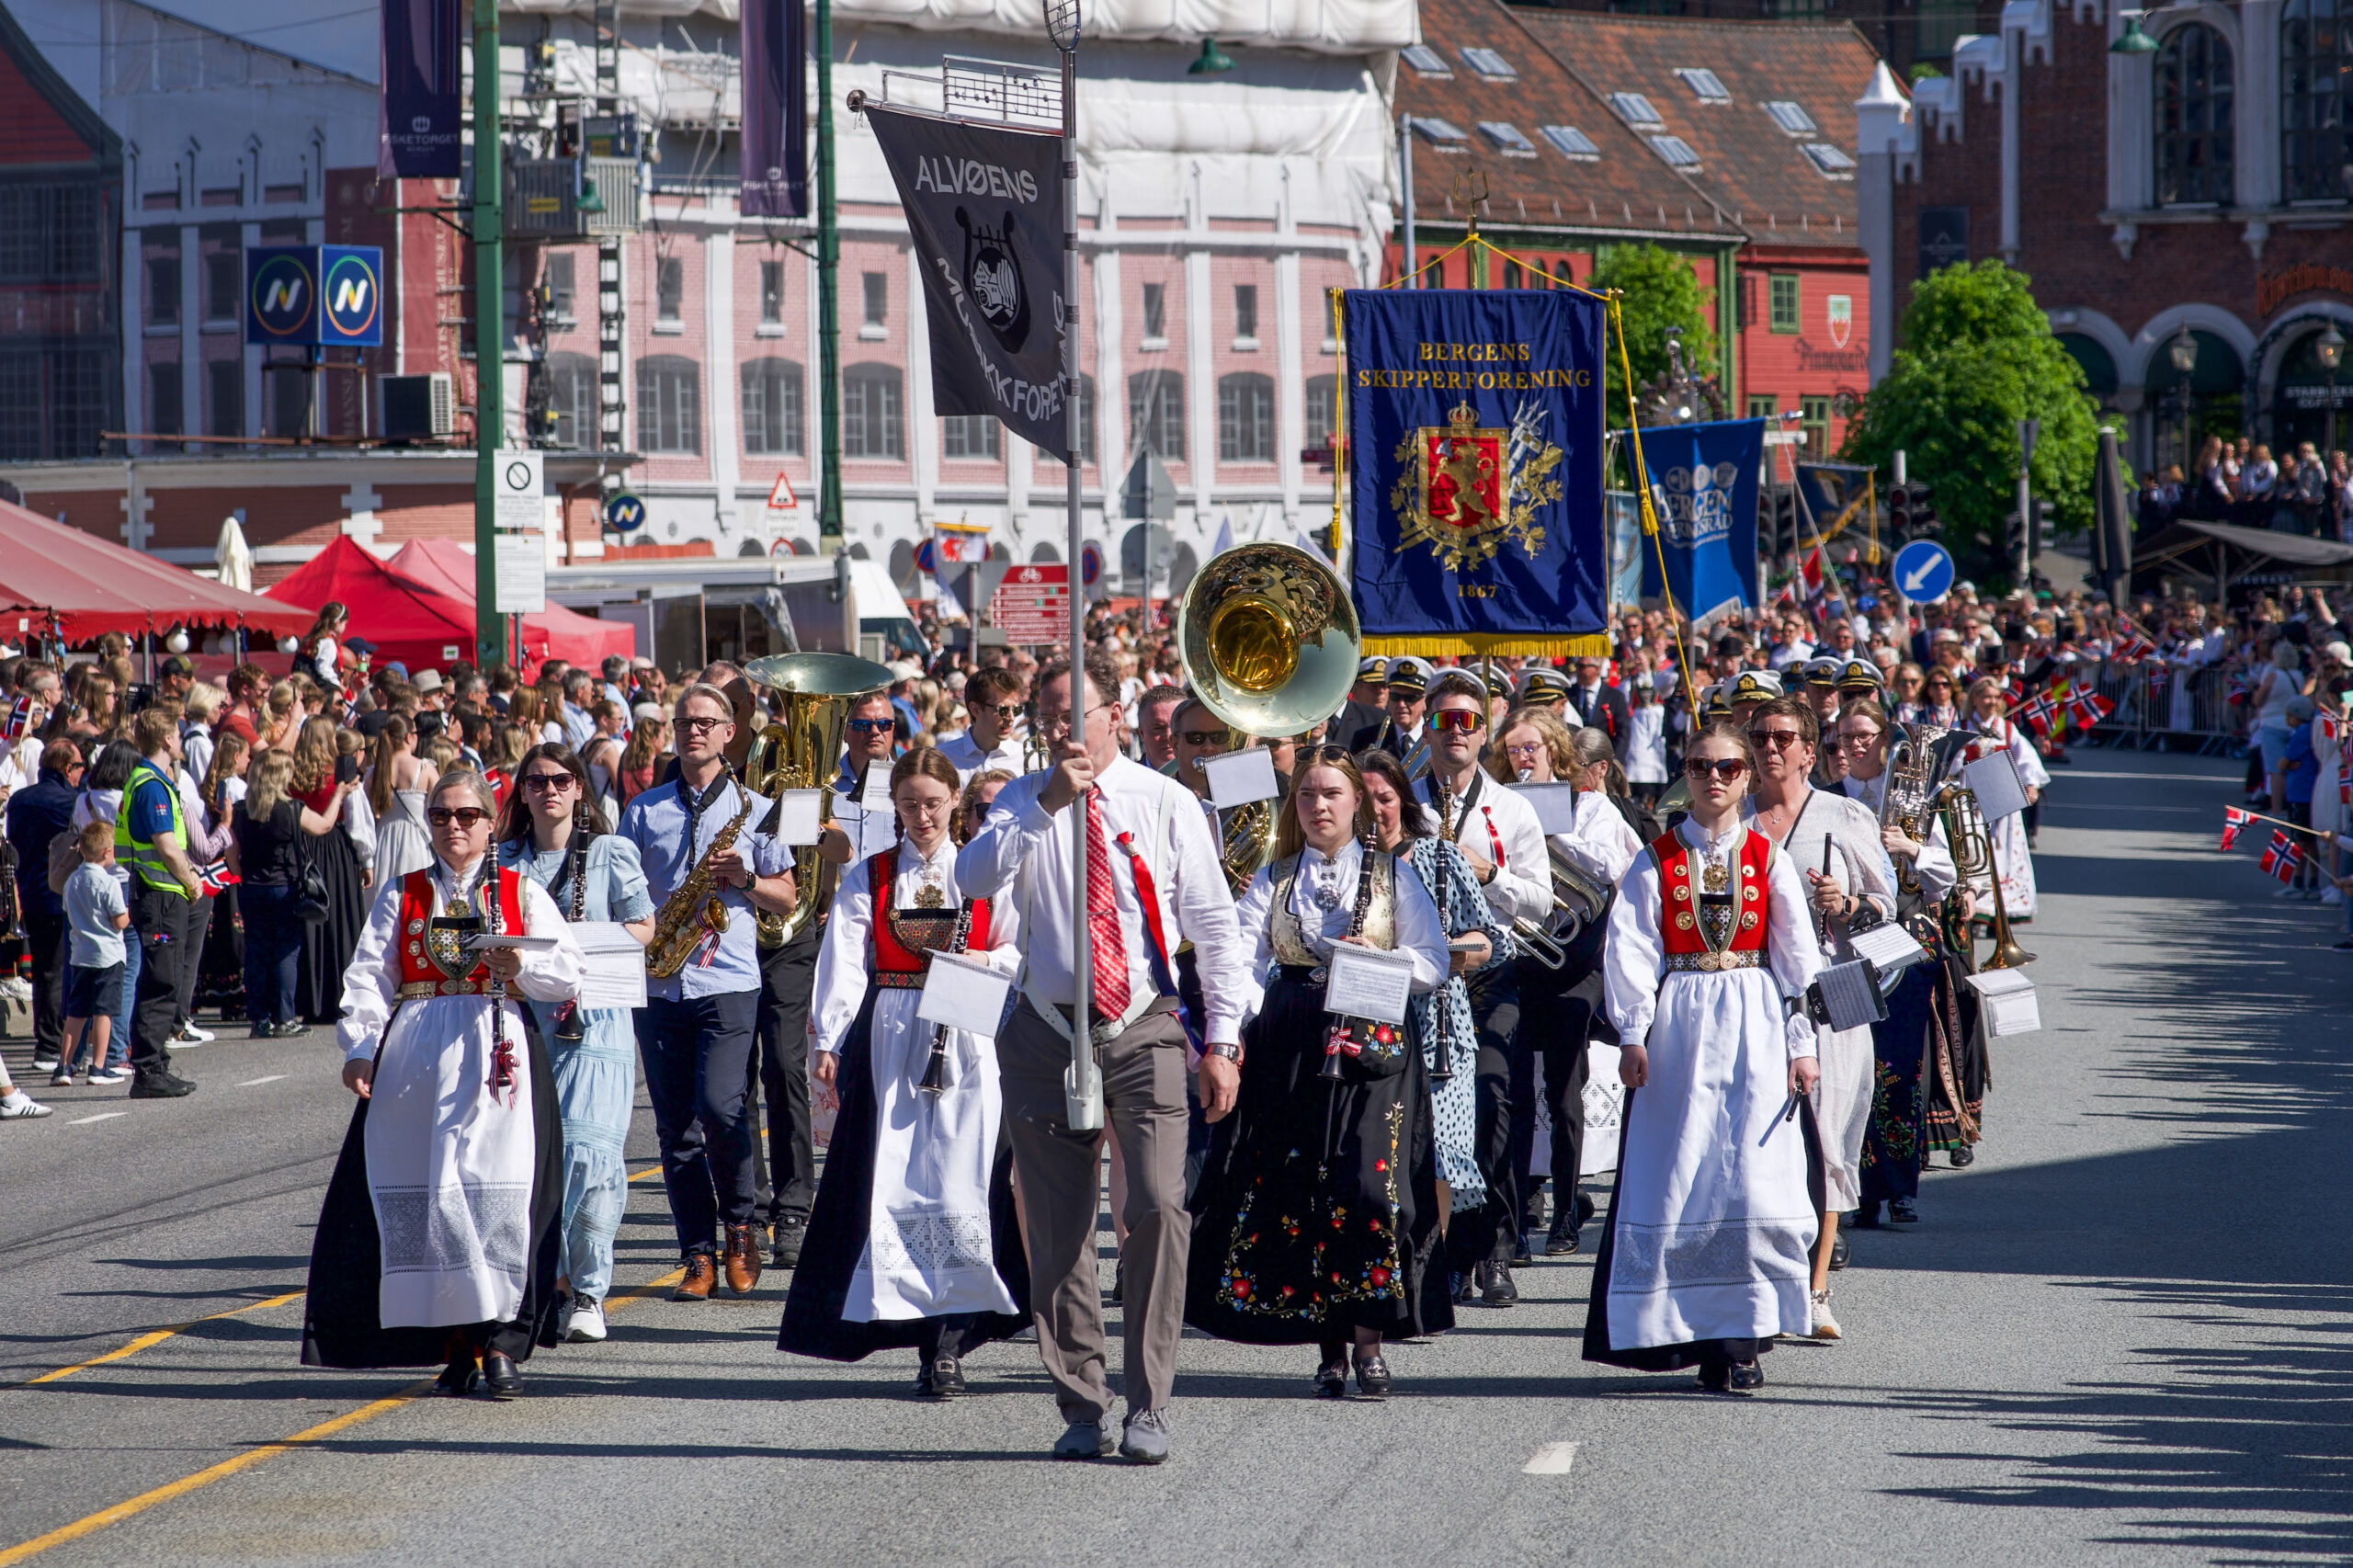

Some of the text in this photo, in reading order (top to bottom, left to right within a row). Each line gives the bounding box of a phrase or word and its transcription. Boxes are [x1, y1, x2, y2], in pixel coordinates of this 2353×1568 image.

[915, 154, 1039, 204] ALVØENS
[1419, 342, 1530, 361] BERGENS
[1358, 369, 1591, 390] SKIPPERFORENING
[1651, 483, 1733, 522] BERGEN
[1458, 585, 1496, 598] 1867
